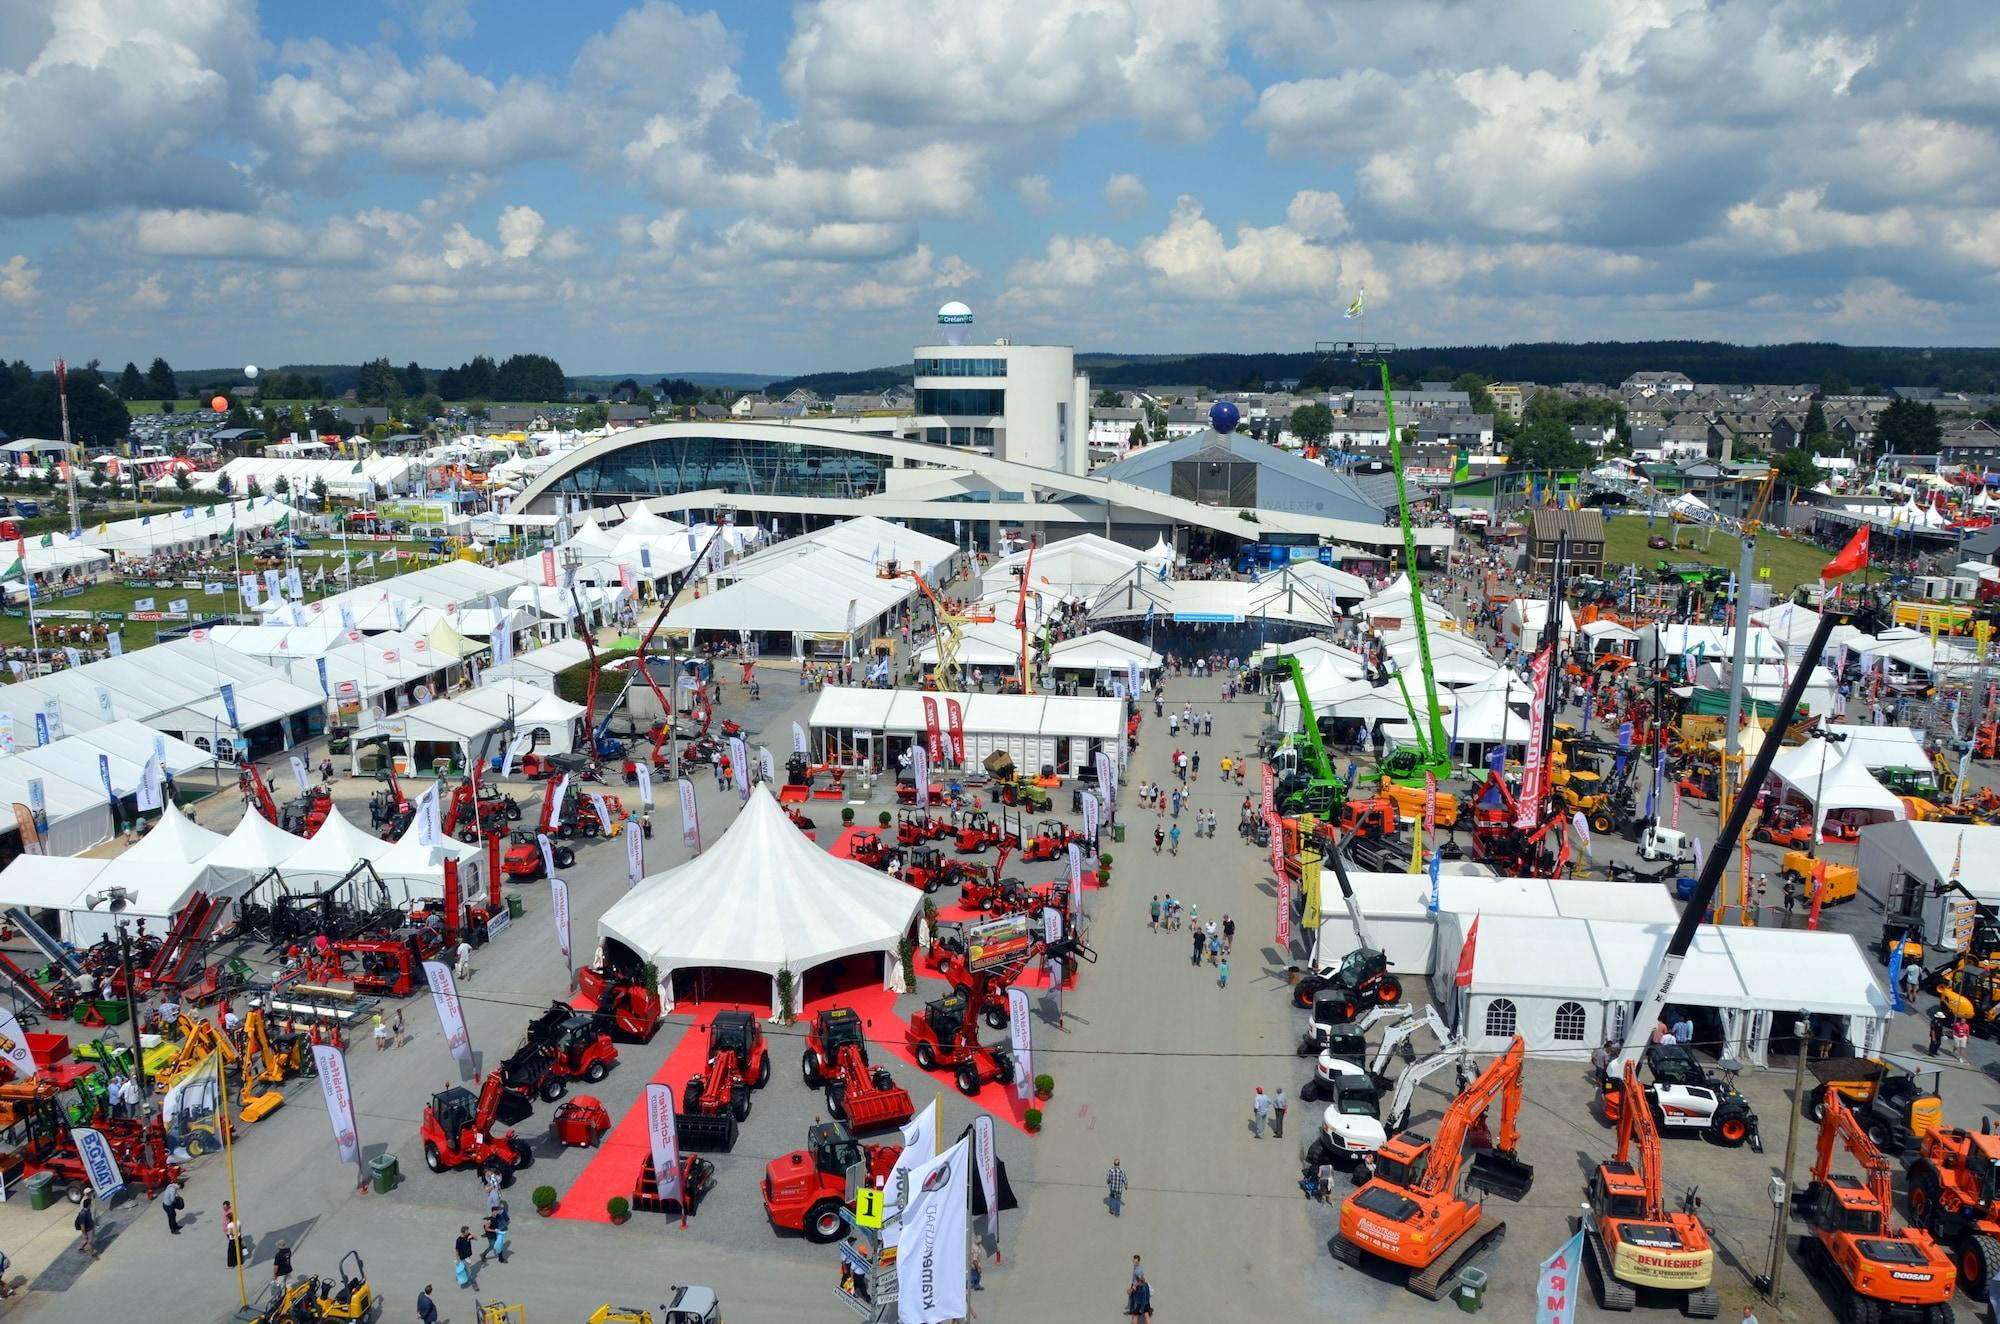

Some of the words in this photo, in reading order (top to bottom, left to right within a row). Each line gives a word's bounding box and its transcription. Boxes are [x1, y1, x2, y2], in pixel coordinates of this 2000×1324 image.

[100, 612, 123, 620] Crelan
[1660, 973, 1675, 994] Bobcat
[1637, 1254, 1704, 1269] DEVLIEGHERE
[1893, 1271, 1931, 1281] DOOSAN
